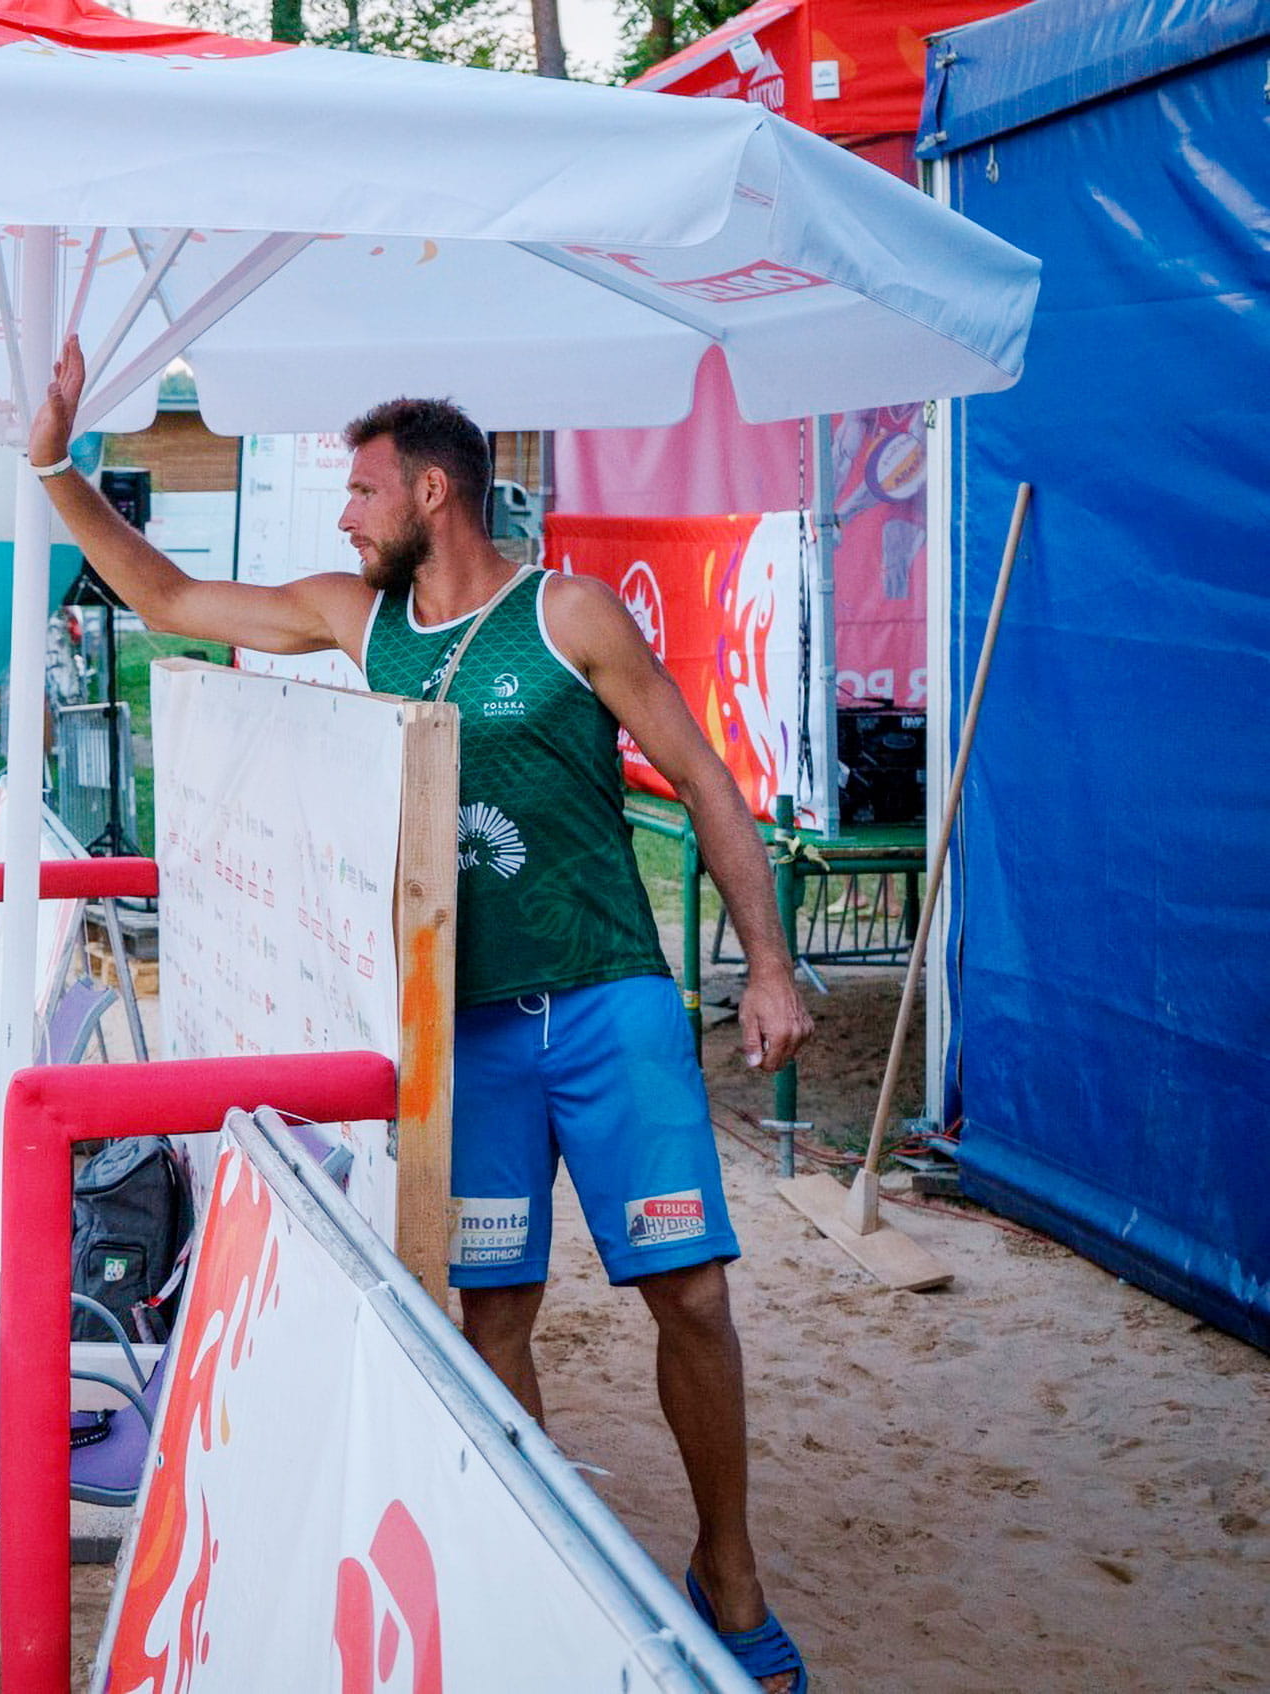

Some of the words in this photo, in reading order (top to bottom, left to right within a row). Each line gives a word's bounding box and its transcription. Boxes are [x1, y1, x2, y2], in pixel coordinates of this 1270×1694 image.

[483, 701, 525, 710] POLSKA
[654, 1203, 697, 1214] TRUCK
[461, 1213, 528, 1230] monta
[645, 1216, 700, 1234] HYDRO
[464, 1247, 523, 1261] DECATHLON
